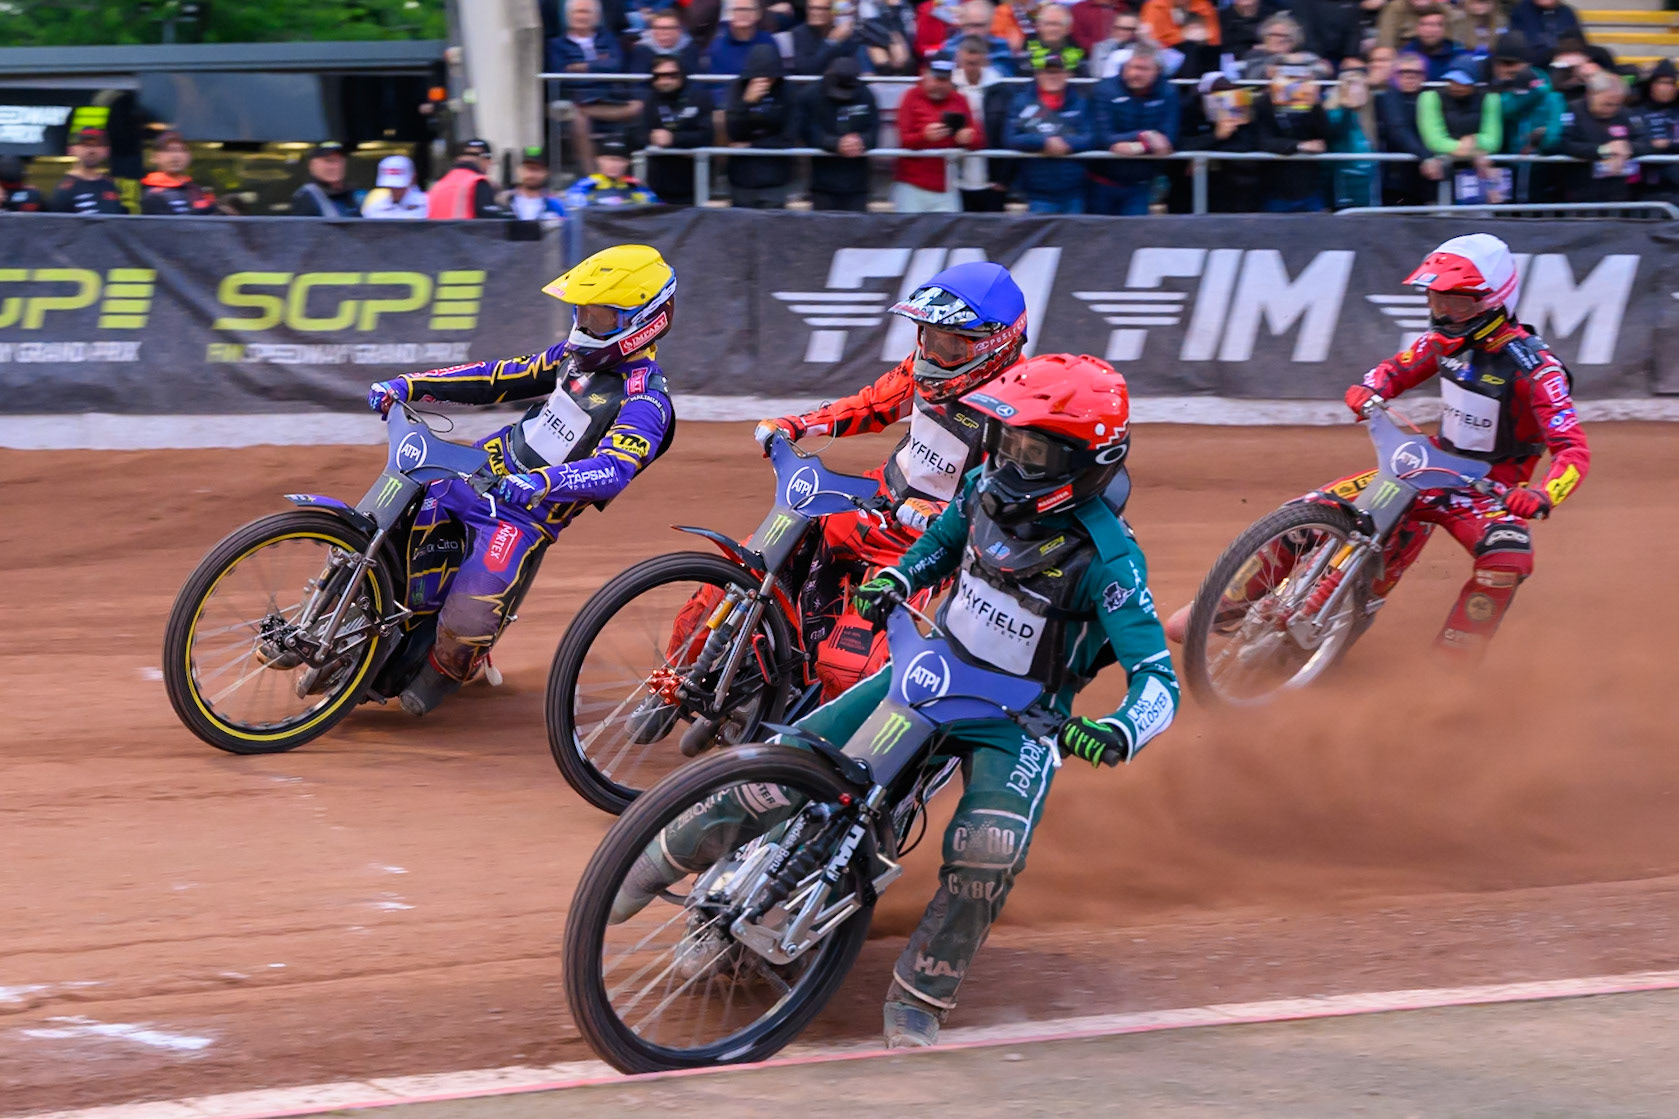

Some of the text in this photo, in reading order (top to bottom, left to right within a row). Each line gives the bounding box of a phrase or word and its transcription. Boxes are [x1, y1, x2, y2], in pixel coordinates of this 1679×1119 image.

[212, 272, 433, 331] SGP
[1072, 248, 1356, 361] FIM
[541, 404, 575, 442] FIELD
[953, 413, 980, 429] SGP
[401, 443, 421, 461] ATPI
[911, 438, 957, 475] YFIELD
[791, 478, 813, 497] ATPI
[490, 524, 511, 560] MARTEX
[986, 621, 1031, 646] EVENTS
[909, 665, 941, 692] ATPI
[769, 815, 806, 874] edes-Benz
